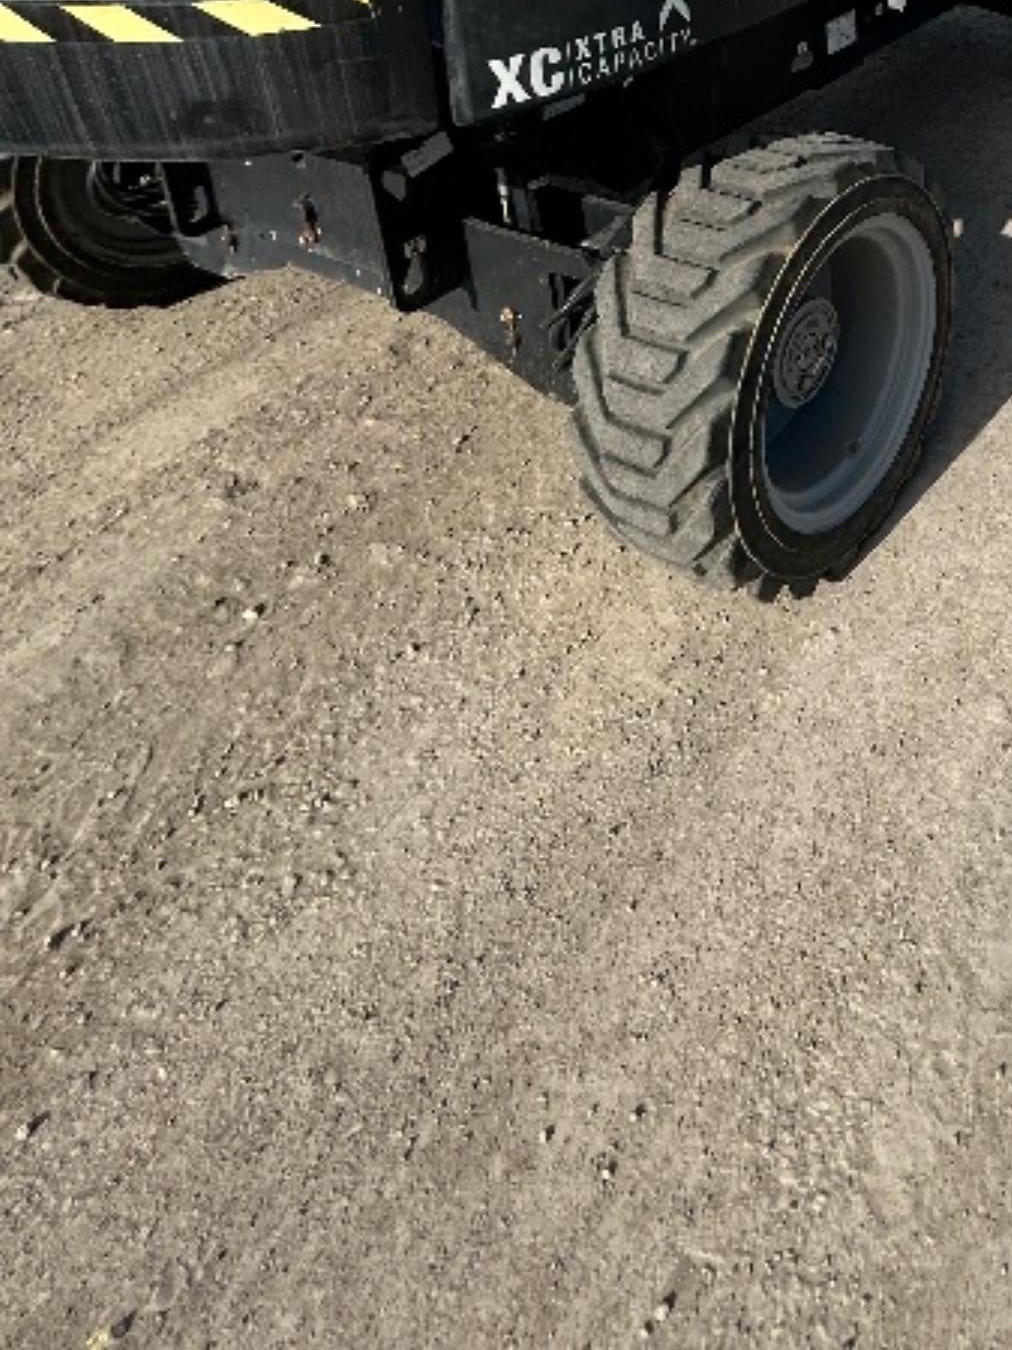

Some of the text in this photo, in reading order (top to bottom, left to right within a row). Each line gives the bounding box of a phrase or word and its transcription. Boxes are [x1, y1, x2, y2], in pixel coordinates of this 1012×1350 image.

[575, 19, 646, 61] XTRA
[578, 27, 693, 85] CAPACITY
[487, 46, 565, 109] XC
